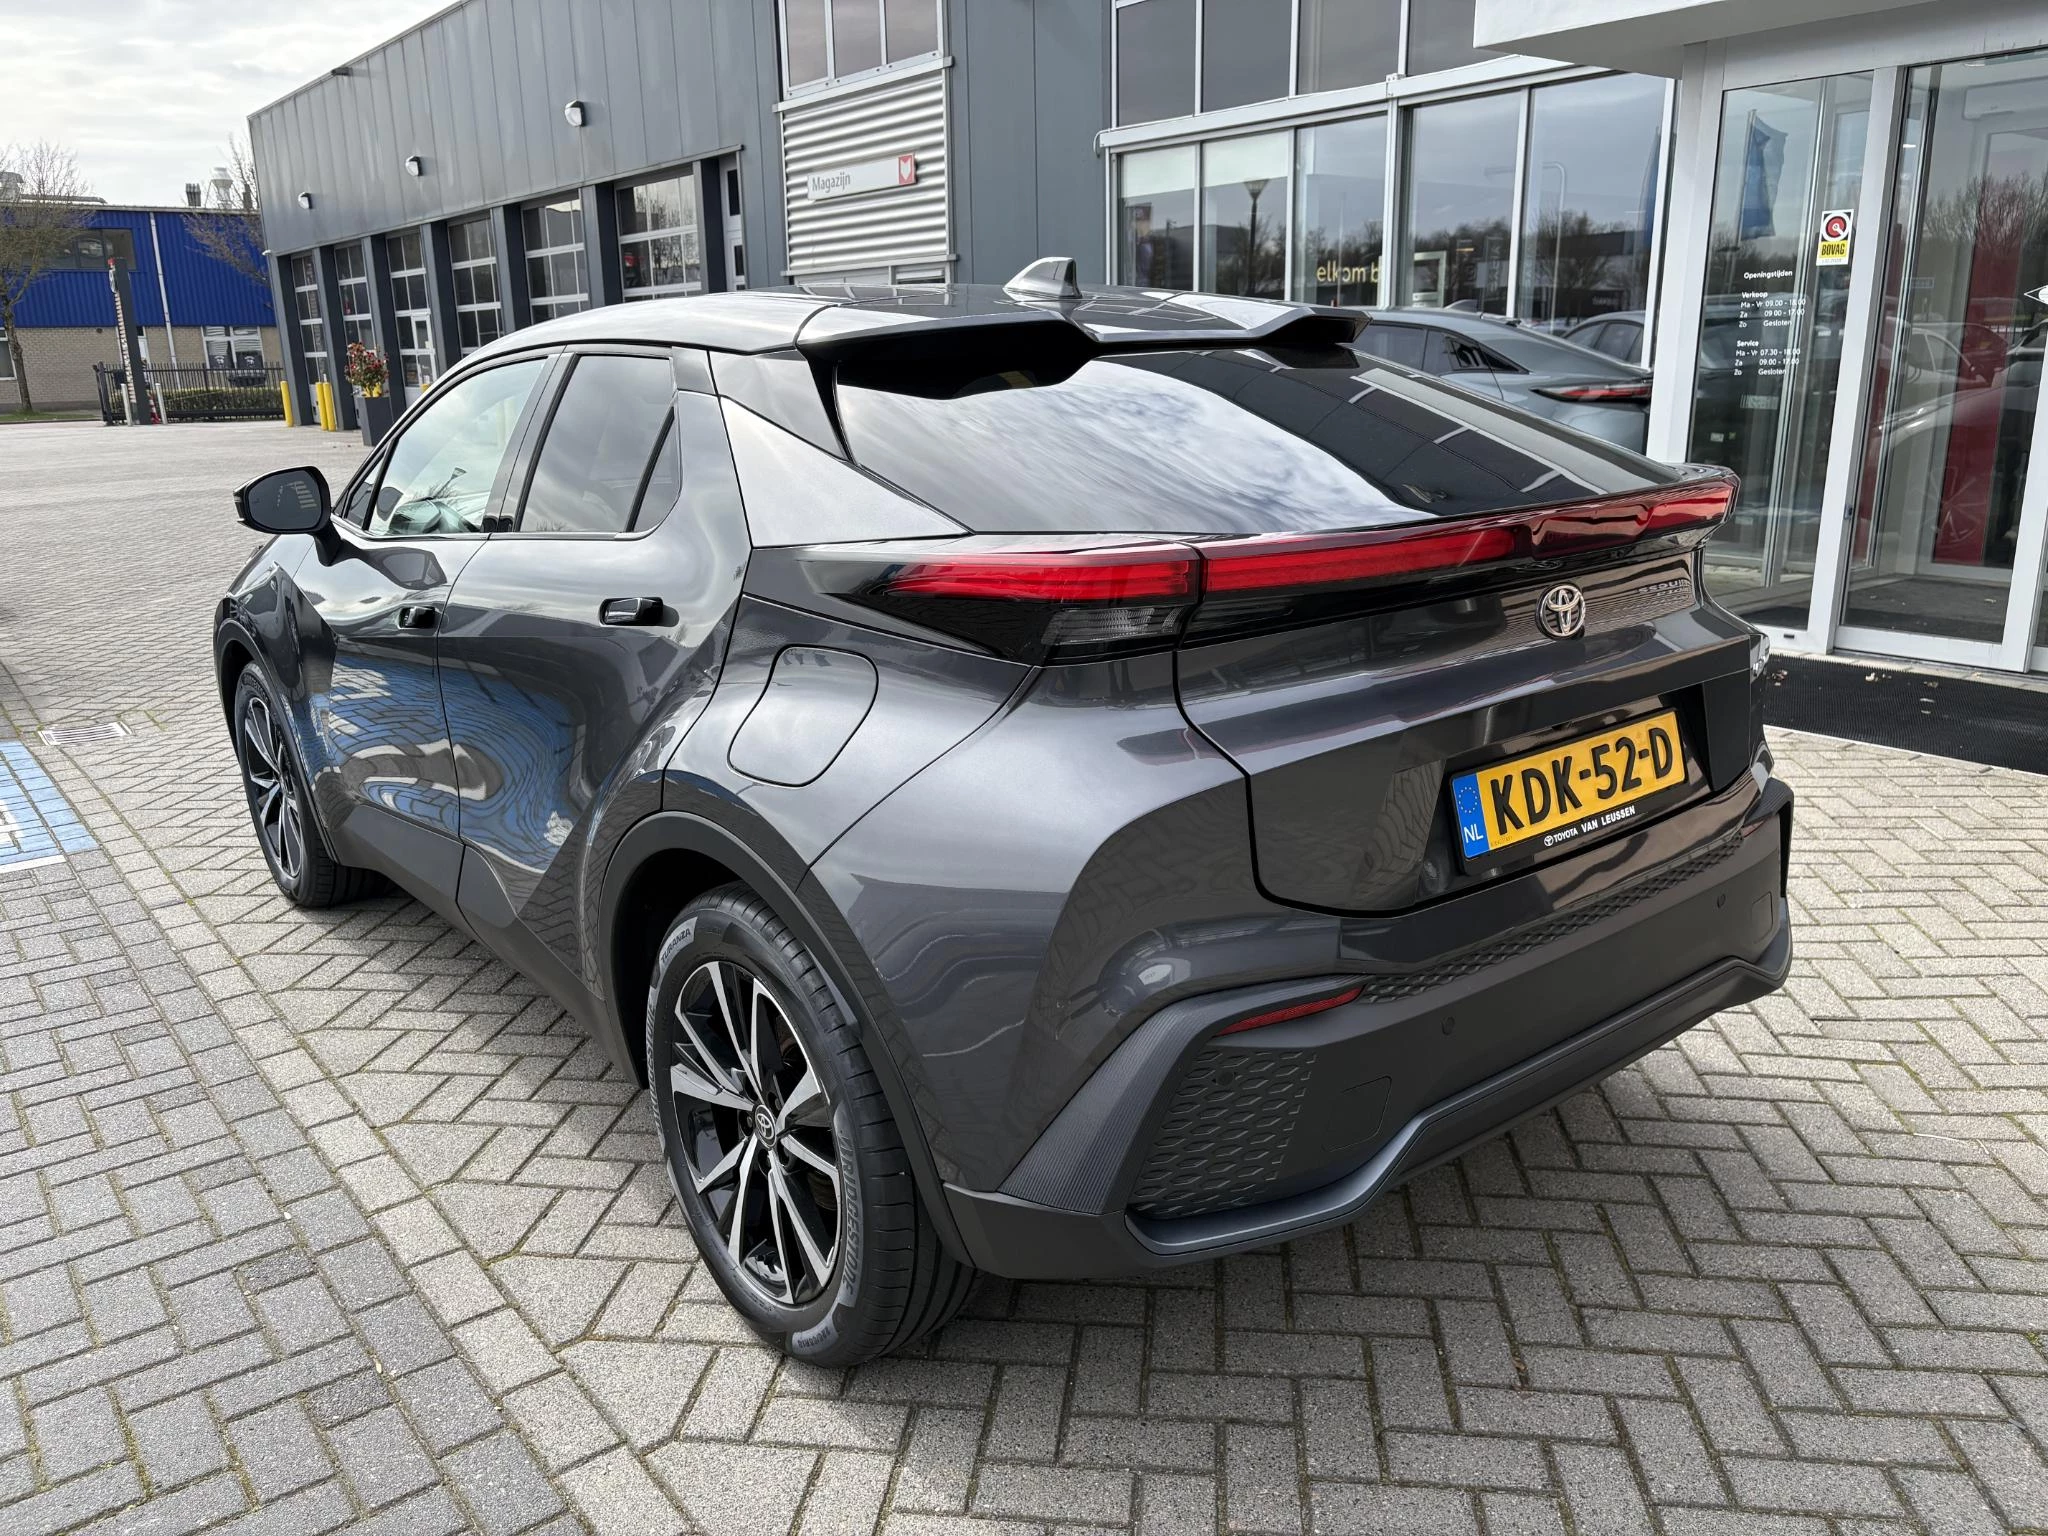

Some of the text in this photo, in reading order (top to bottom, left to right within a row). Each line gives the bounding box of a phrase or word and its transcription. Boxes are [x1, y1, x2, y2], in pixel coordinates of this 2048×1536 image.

[812, 172, 851, 193] Magazijn
[1821, 243, 1846, 256] BOVAG
[1743, 270, 1793, 280] Openingstijden
[1742, 291, 1768, 299] Verkoop
[1763, 319, 1793, 327] Gesloten
[1760, 348, 1778, 356] 07.30
[1735, 359, 1743, 367] Za
[1759, 358, 1777, 366] 09.00
[1490, 727, 1673, 836] KDK-52-D
[1553, 805, 1636, 843] TOYOTA VAN LEUSSEN
[1463, 823, 1484, 844] NL
[660, 927, 692, 964] TURANZA
[838, 1136, 860, 1296] BRIDGESTONE
